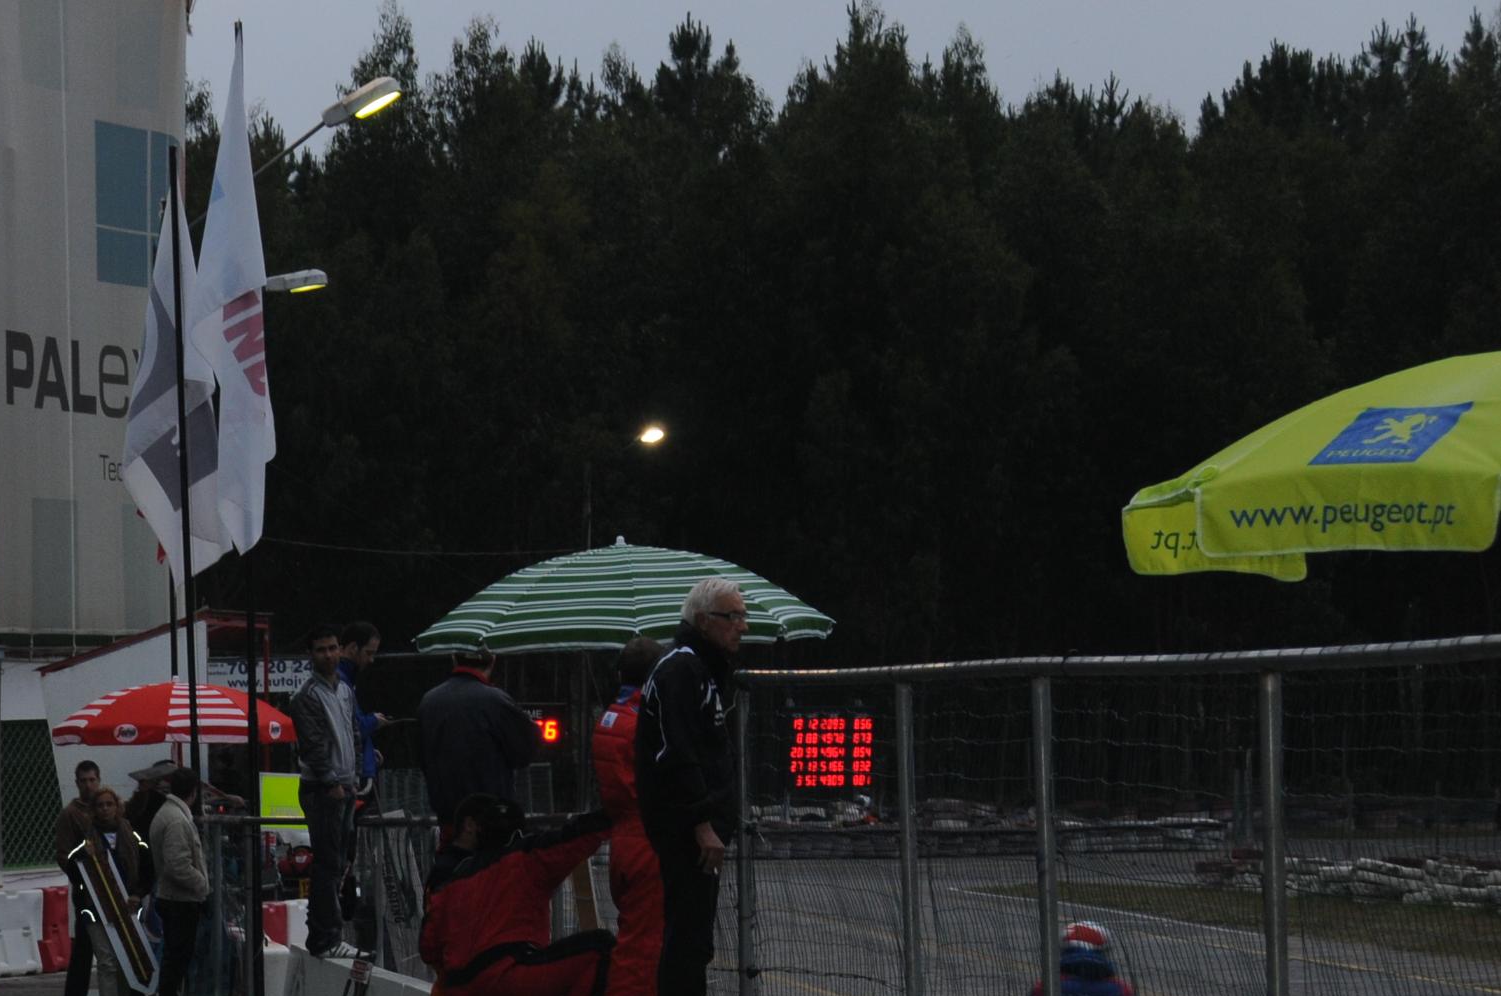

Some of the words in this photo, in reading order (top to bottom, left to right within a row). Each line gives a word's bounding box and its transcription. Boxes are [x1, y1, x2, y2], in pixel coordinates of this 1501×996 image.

[6, 329, 140, 419] PALe
[1326, 447, 1417, 459] PEUGEOT
[1230, 501, 1456, 534] www.peugeot.pt
[537, 720, 558, 740] 6
